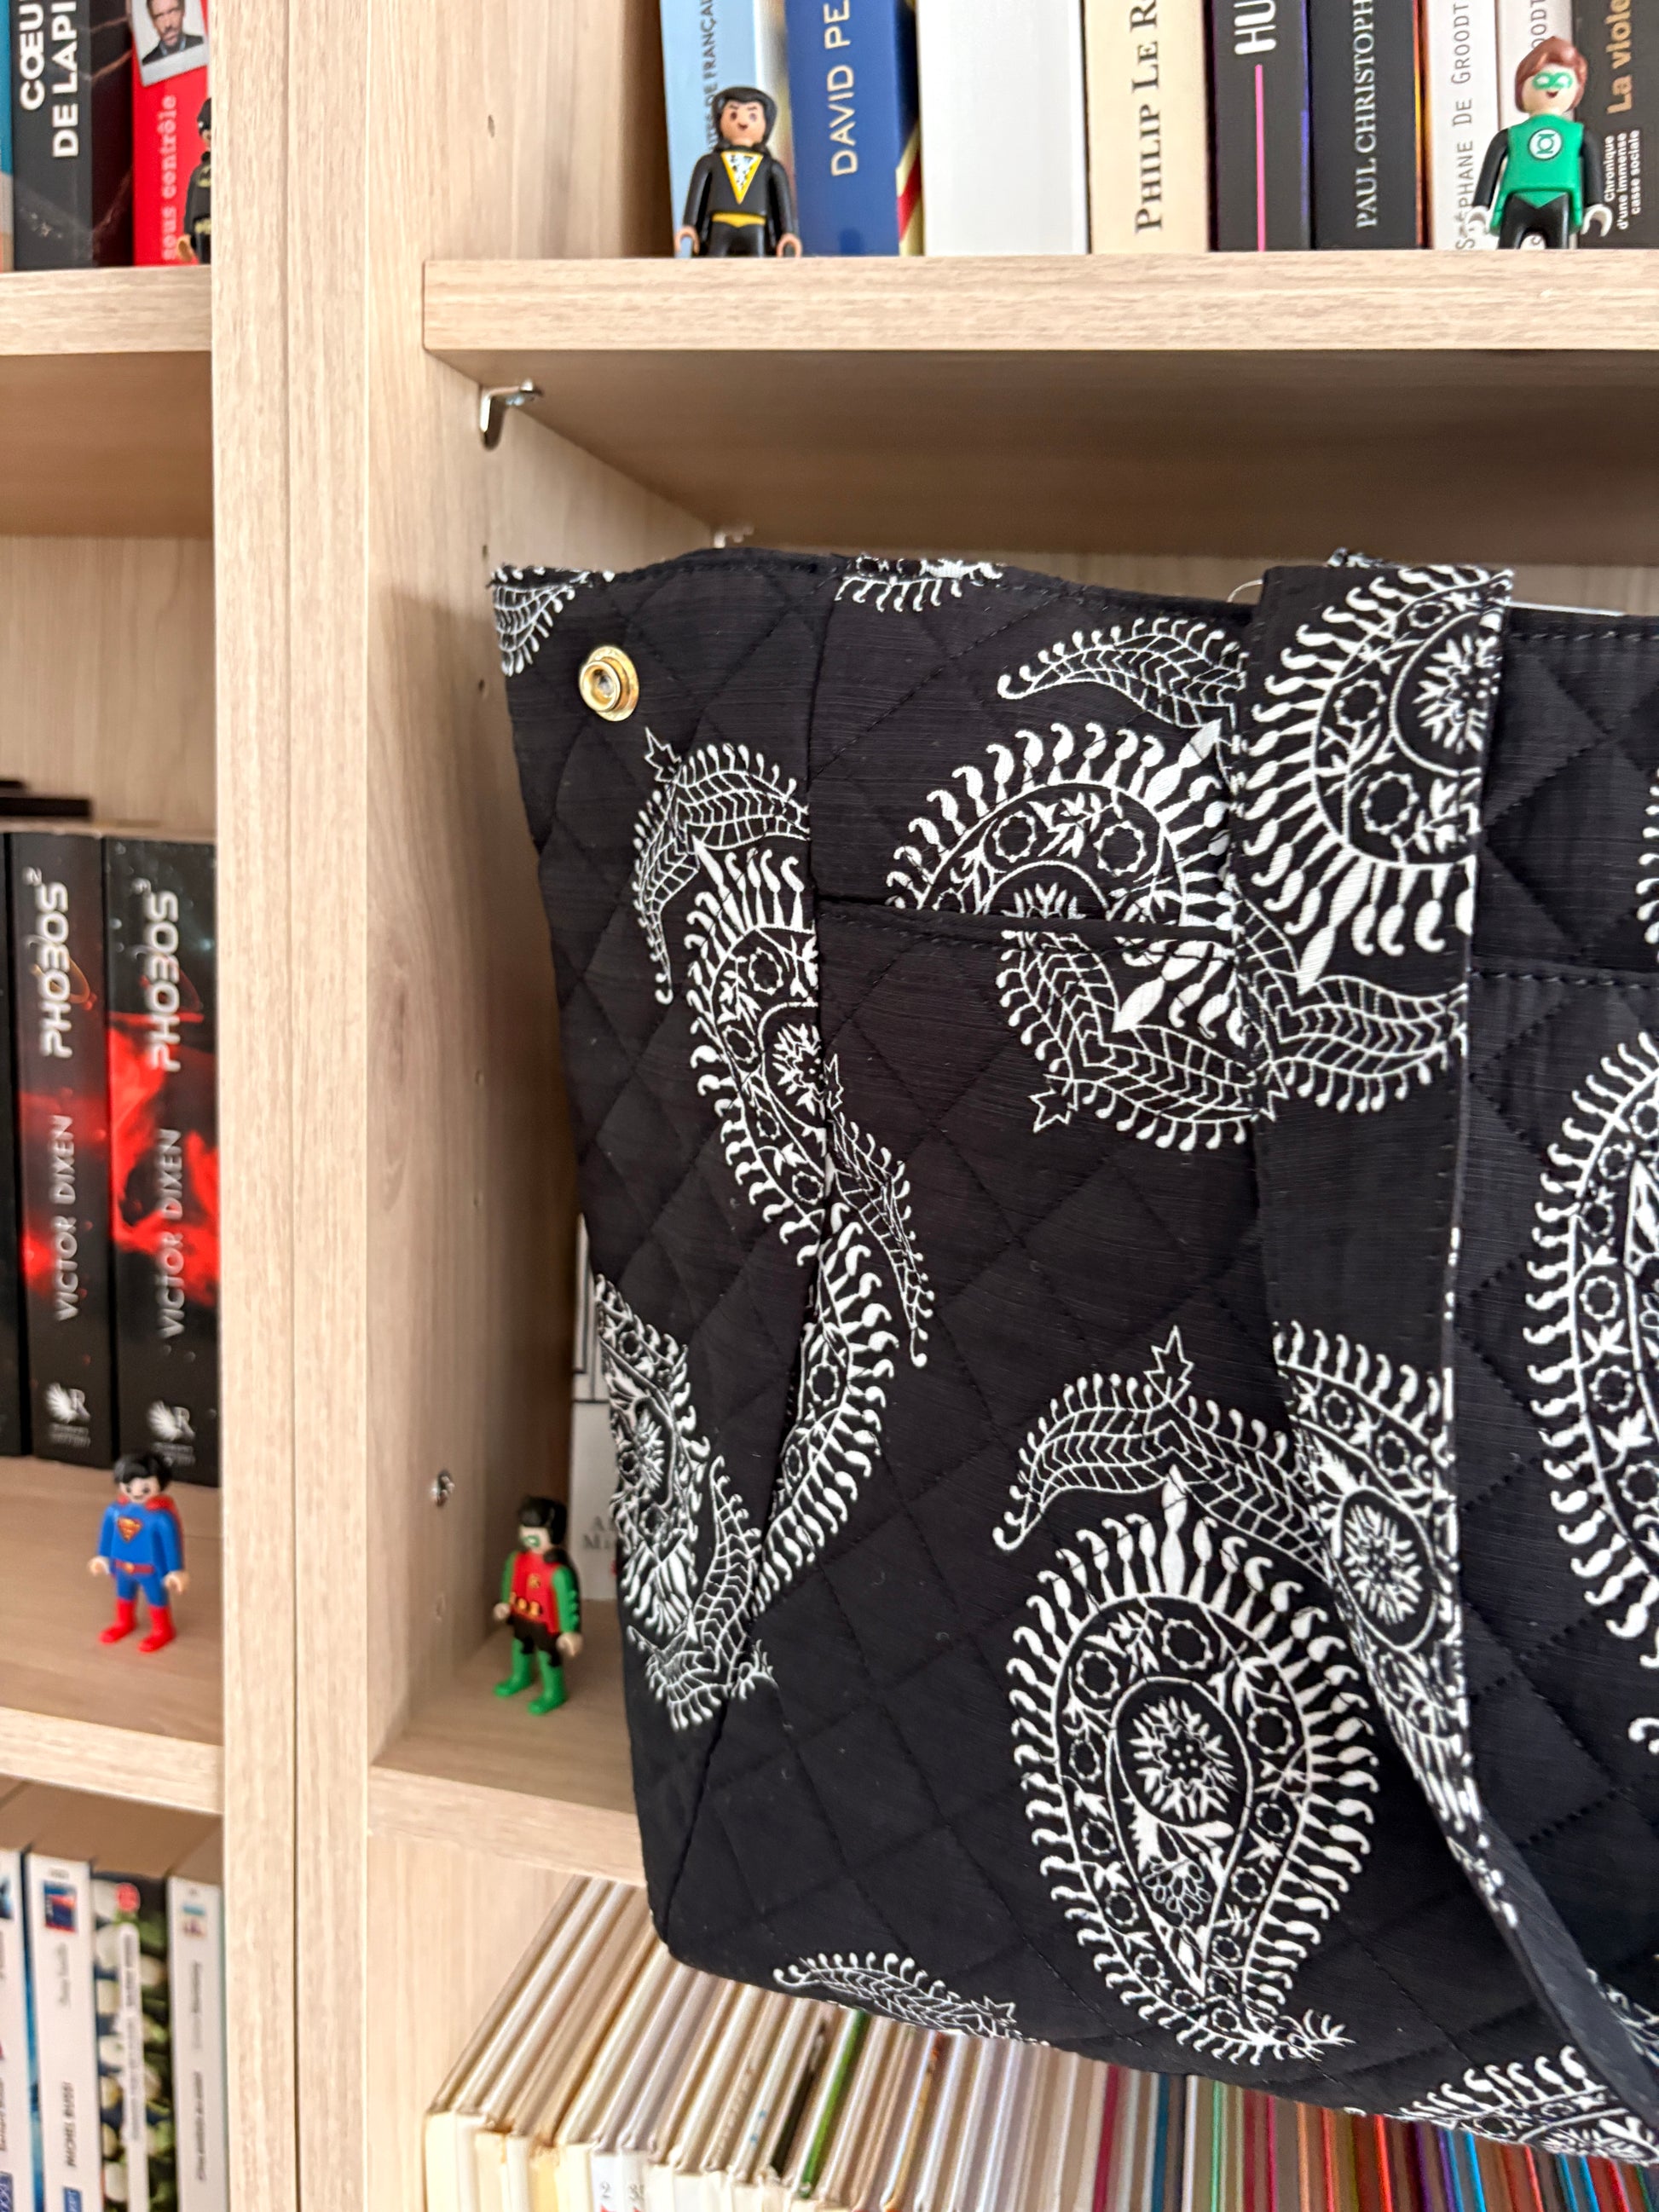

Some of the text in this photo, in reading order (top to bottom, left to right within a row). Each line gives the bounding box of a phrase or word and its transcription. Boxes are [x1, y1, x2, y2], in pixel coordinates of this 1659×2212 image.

[19, 0, 45, 111] CŒU
[1129, 0, 1158, 33] R
[1233, 0, 1277, 55] HU
[1451, 2, 1471, 84] GROODT
[50, 2, 79, 159] DE LAPI
[823, 0, 858, 176] DAVID PE
[1352, 0, 1377, 229] PAUL CHRISTOPH
[1453, 98, 1473, 127] DE
[1606, 74, 1633, 114] La
[157, 95, 177, 261] sous contrôle
[1134, 103, 1163, 235] PHILIP
[1603, 135, 1616, 203] Chronique
[1616, 132, 1629, 230] d'une immense
[1627, 130, 1641, 215] casse sociale
[49, 1114, 79, 1322] VICTOR DIXEN
[154, 1129, 185, 1339] VICTOR DIXEN
